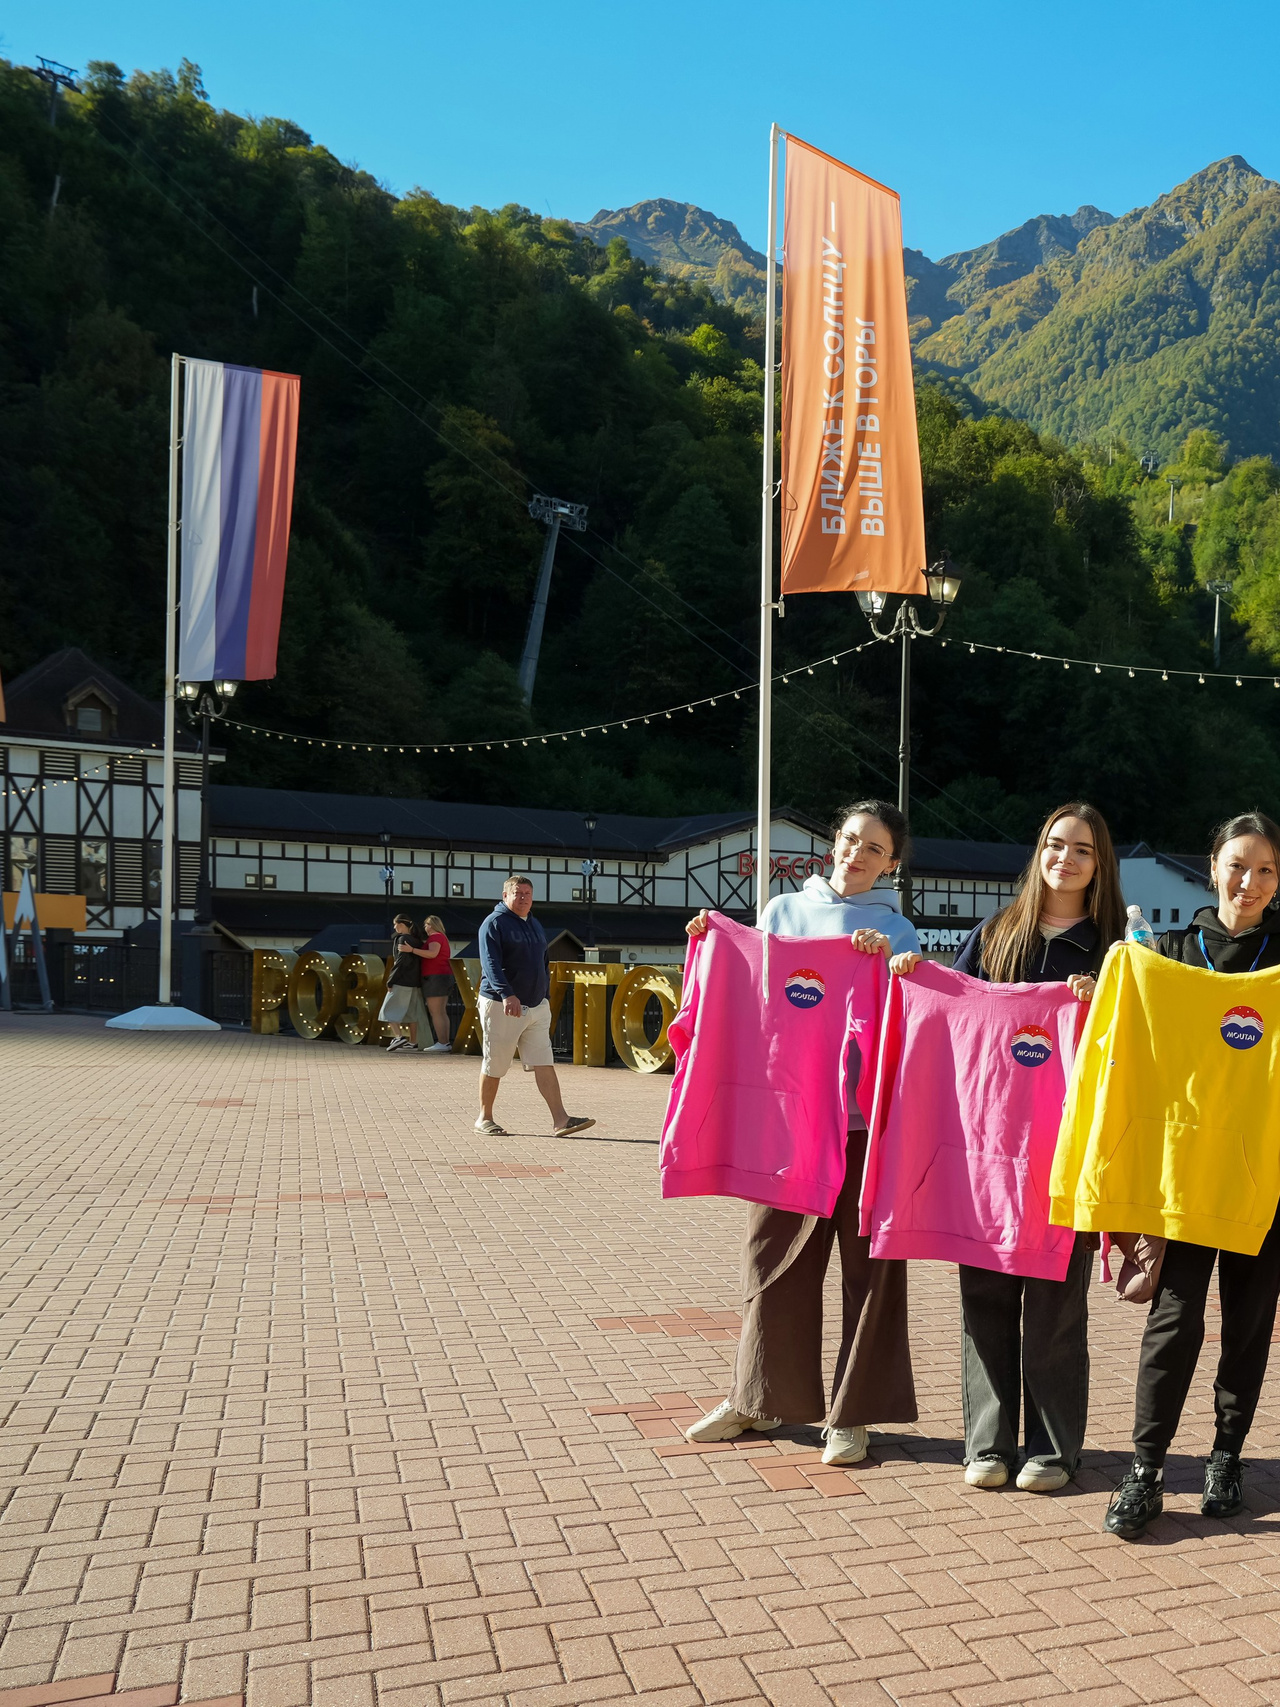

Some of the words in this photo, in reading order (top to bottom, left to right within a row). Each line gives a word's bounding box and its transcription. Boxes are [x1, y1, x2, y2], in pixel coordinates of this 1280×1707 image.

[822, 236, 847, 379] СОЛНЦУ
[855, 316, 879, 404] ГОРЫ
[822, 388, 844, 409] К
[856, 413, 880, 433] В
[821, 418, 846, 535] БЛИЖЕ
[857, 441, 885, 537] ВЫШЕ
[790, 991, 817, 1002] MOUTAI
[1226, 1031, 1256, 1042] MOUTAI
[1016, 1049, 1045, 1059] MOUTAI
